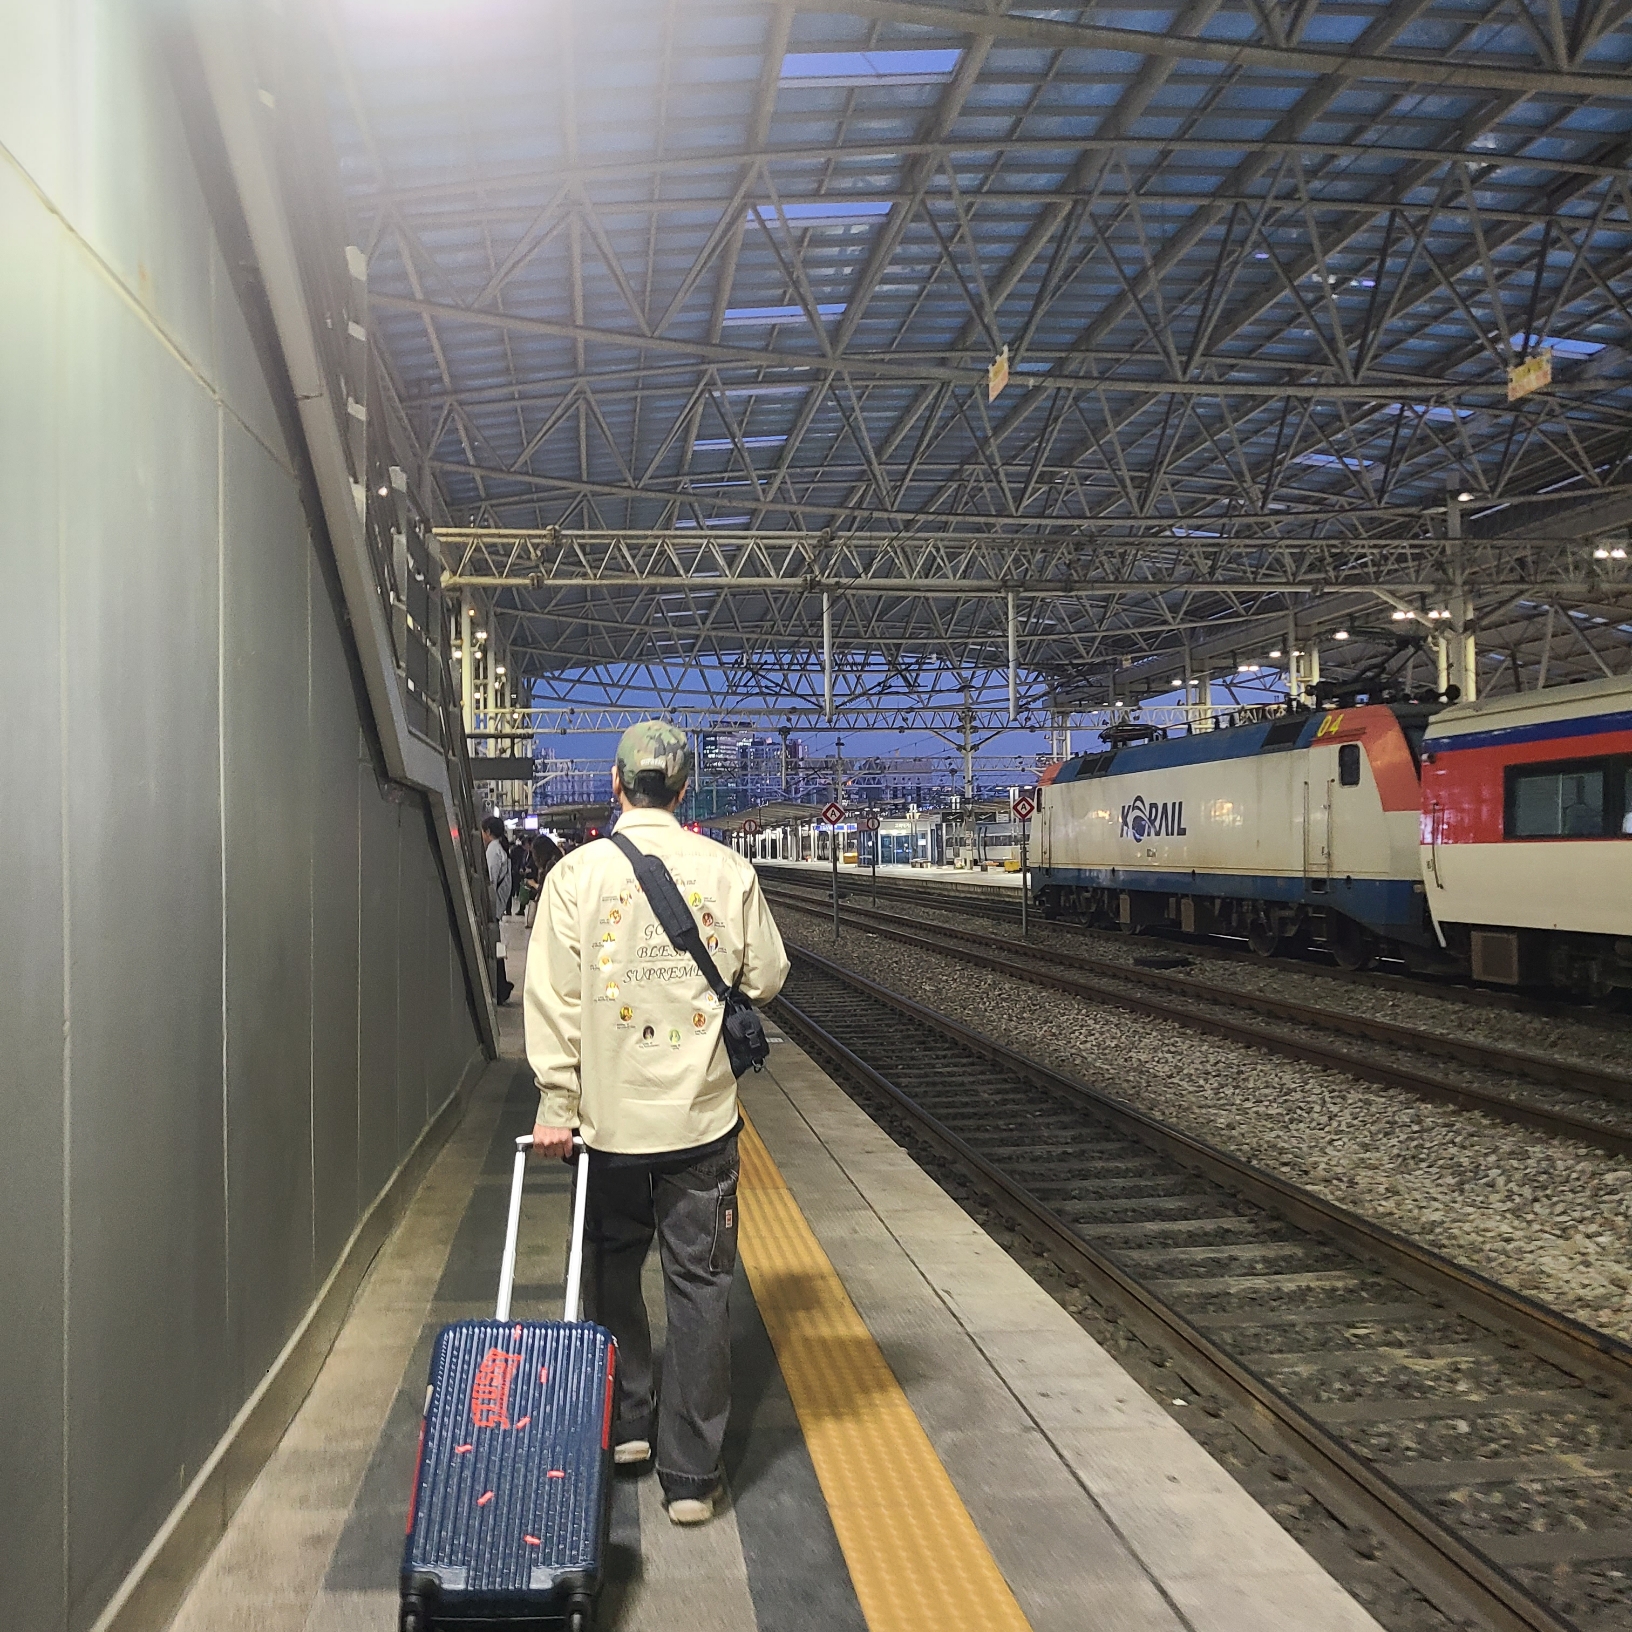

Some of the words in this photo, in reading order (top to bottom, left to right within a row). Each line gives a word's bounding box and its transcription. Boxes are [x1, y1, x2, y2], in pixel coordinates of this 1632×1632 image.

[1317, 714, 1344, 737] 04
[1120, 795, 1186, 843] KORAIL
[472, 1347, 522, 1430] STUSSY
